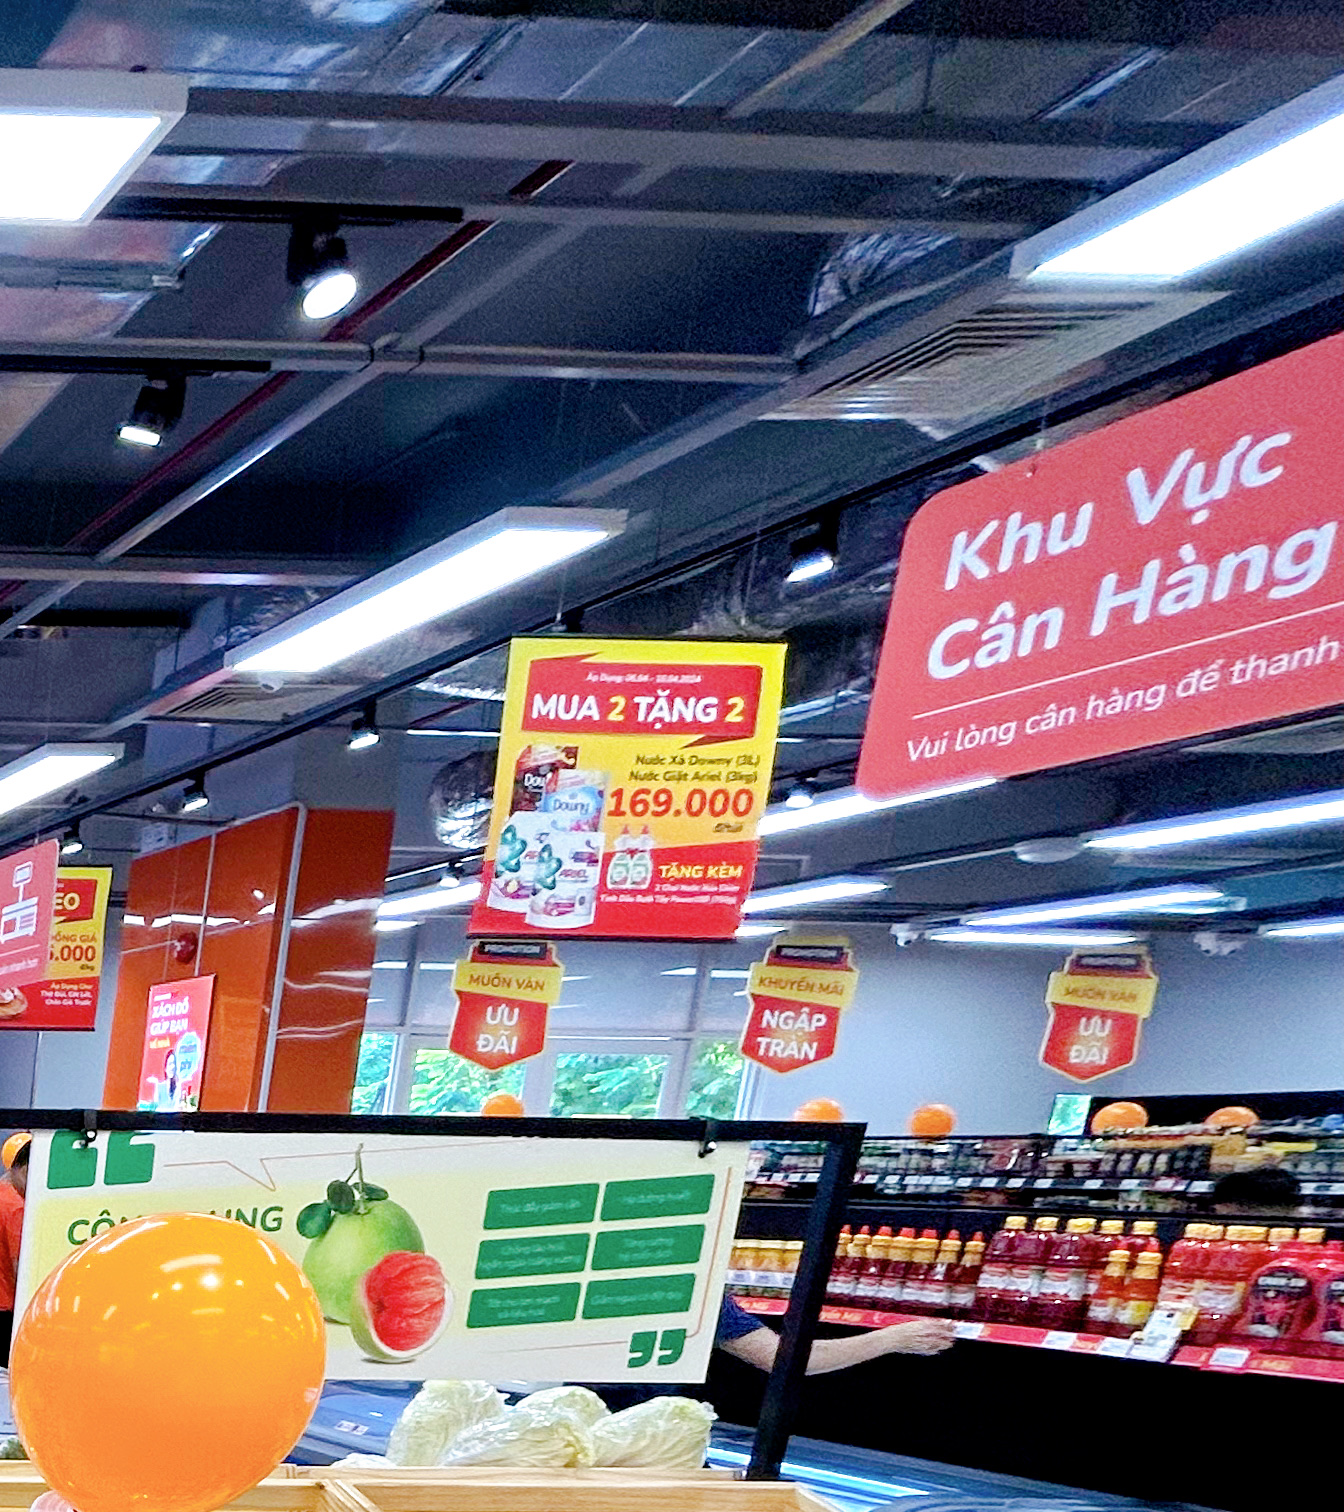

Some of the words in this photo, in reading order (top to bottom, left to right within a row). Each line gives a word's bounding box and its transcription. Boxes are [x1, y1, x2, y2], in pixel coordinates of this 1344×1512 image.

[944, 503, 1094, 591] Khu
[1126, 432, 1292, 525] Vực
[927, 601, 1065, 680] Cân
[1089, 521, 1339, 637] Hàng
[531, 693, 600, 721] MUA
[607, 695, 626, 722] 2
[633, 688, 719, 730] TẶNG
[724, 695, 745, 723] 2
[907, 734, 948, 762] Vui
[955, 720, 1017, 752] lòng
[1025, 703, 1077, 733] cân
[1086, 682, 1167, 721] hàng
[1176, 659, 1221, 700] để
[1229, 636, 1341, 687] thanh
[607, 788, 754, 818] 169.000
[486, 1003, 520, 1026] ƯU
[761, 1006, 828, 1036] NGẬP
[1078, 1015, 1112, 1037] ƯU
[476, 1029, 518, 1055] ĐÃI
[756, 1034, 818, 1061] TRÀN
[1068, 1040, 1109, 1066] ĐÃI
[209, 1205, 284, 1233] NG
